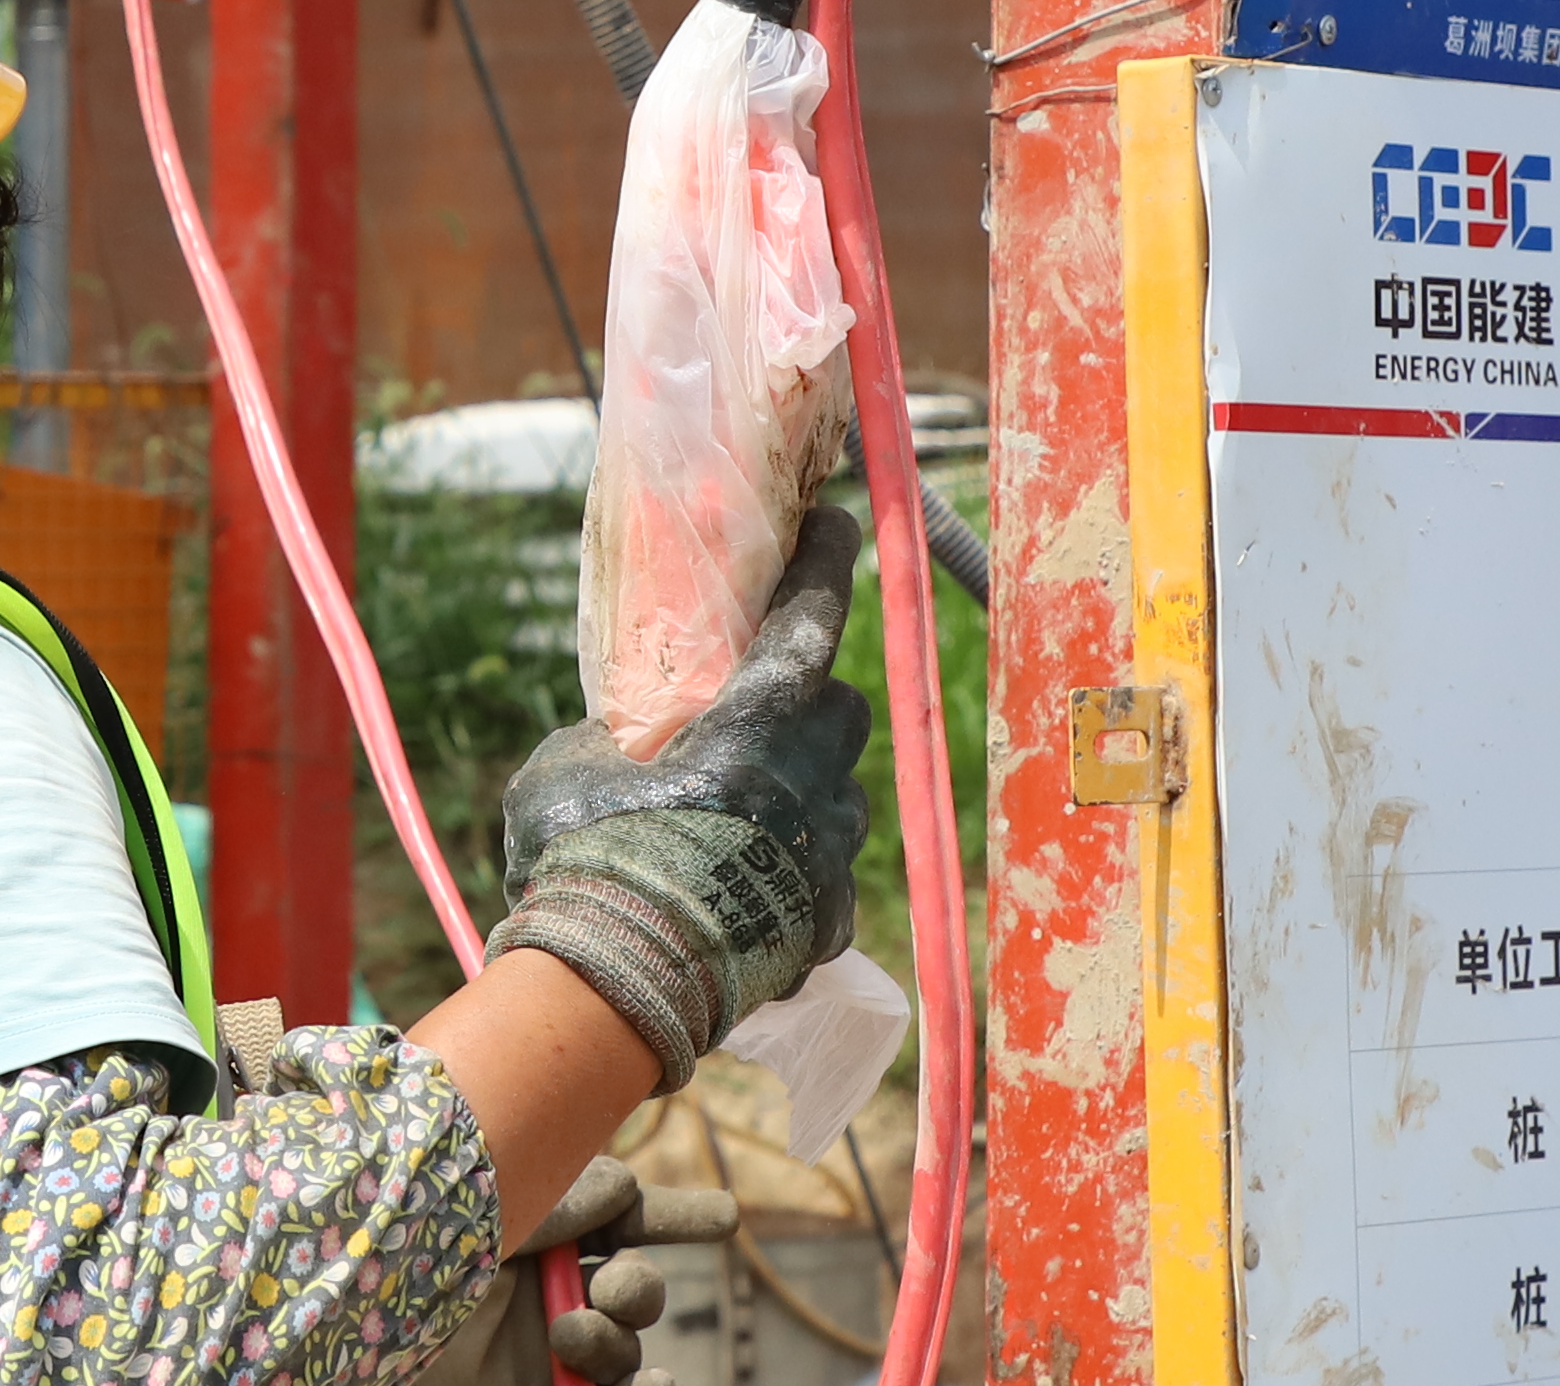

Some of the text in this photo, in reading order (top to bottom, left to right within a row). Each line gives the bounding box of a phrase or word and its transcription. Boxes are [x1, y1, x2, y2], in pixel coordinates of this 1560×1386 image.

[1372, 143, 1552, 252] CEEC
[1375, 273, 1554, 346] 中国能建
[1375, 354, 1559, 388] ENERGY CHINA
